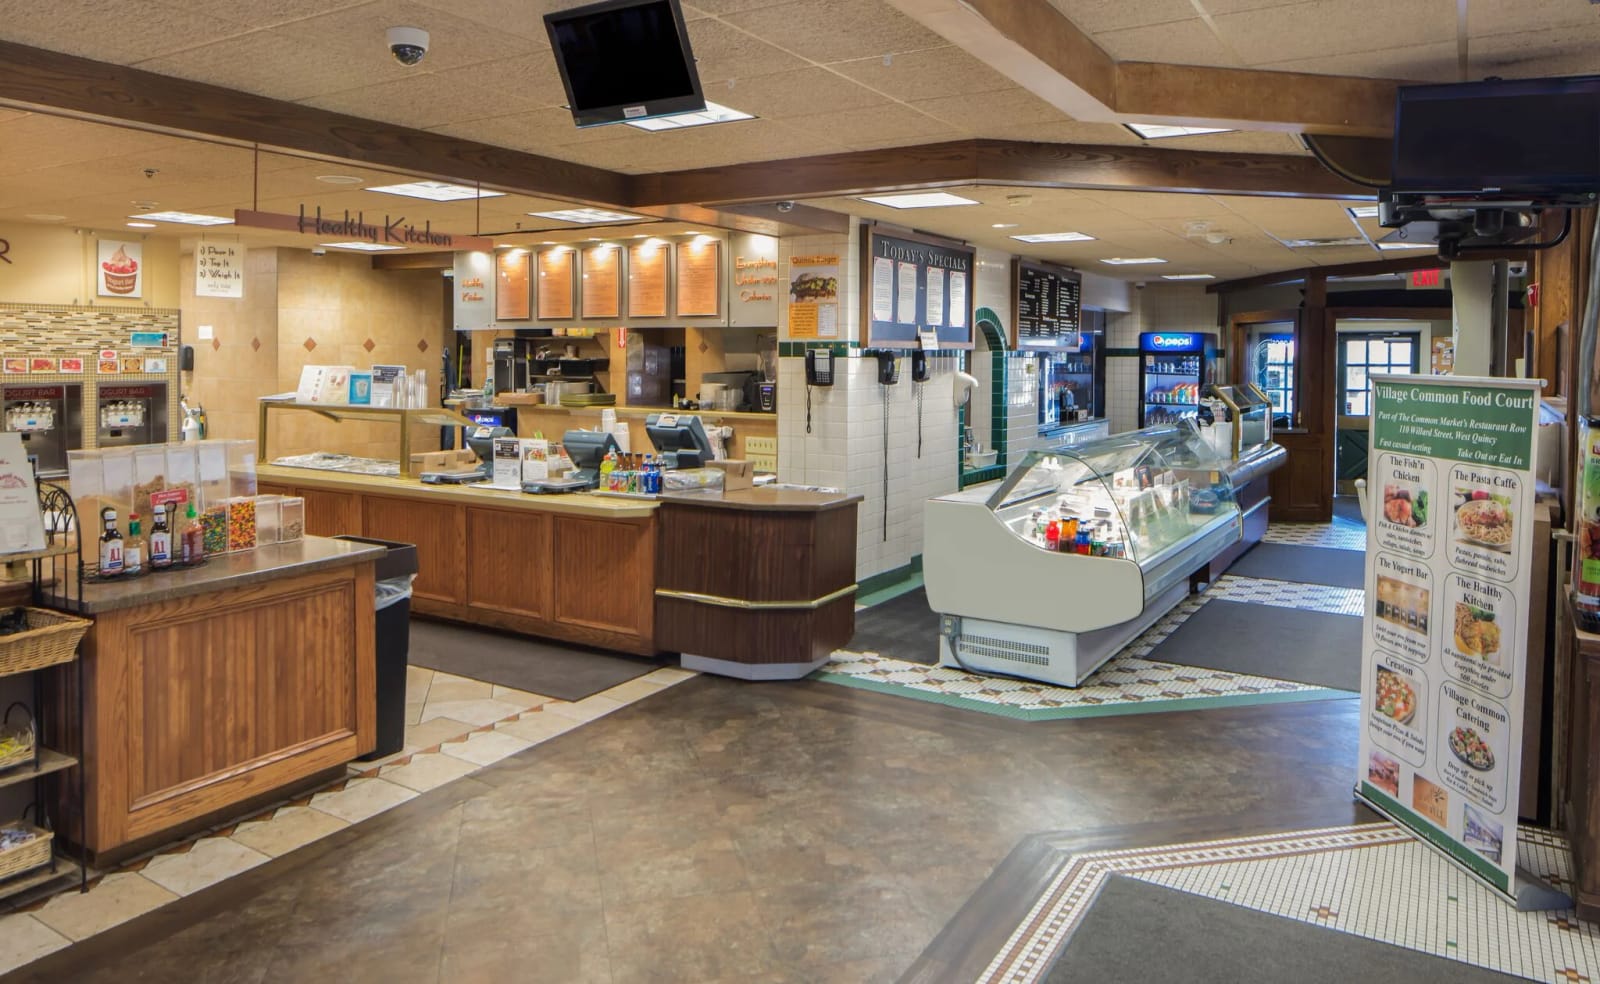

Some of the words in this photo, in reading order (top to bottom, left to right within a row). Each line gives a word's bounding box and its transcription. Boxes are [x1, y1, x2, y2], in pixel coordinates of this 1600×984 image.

[298, 204, 378, 243] Healthy
[384, 215, 452, 246] Kitchen
[882, 240, 924, 262] TODAY'S
[928, 250, 966, 270] SPECIALS
[1413, 269, 1439, 287] EXIT
[1164, 336, 1192, 347] pepsi
[1376, 386, 1408, 404] Village
[1410, 388, 1458, 404] Common
[1462, 390, 1492, 406] Food
[1496, 393, 1532, 408] Court
[1379, 411, 1390, 420] Part
[1391, 412, 1398, 422] of
[1399, 412, 1410, 422] The
[1411, 414, 1438, 425] Common
[1440, 416, 1468, 428] Market's
[1470, 419, 1508, 432] Restaurant
[1510, 422, 1527, 433] Row
[1380, 438, 1392, 448] Fast
[1392, 441, 1412, 450] casual
[1412, 444, 1432, 454] setting
[1410, 426, 1432, 437] Willard
[1456, 430, 1470, 441] West
[1472, 432, 1498, 446] Quincy
[1390, 456, 1402, 466] The
[1458, 448, 1473, 458] Take
[1474, 450, 1488, 461] Out
[1488, 454, 1498, 462] or
[1498, 452, 1512, 464] Eat
[1513, 455, 1522, 466] In
[1392, 469, 1420, 483] Chicken
[1455, 470, 1468, 482] The
[1470, 472, 1490, 486] Pasta
[1494, 476, 1517, 490] Caffe
[1380, 557, 1391, 568] The
[1416, 568, 1428, 580] Bar
[1456, 576, 1471, 590] The
[1474, 581, 1502, 602] Healthy
[1464, 592, 1494, 612] Kitchen
[1386, 656, 1413, 676] Creation
[1444, 686, 1469, 706] Village
[1472, 698, 1506, 723] Common
[1456, 706, 1490, 734] Catering
